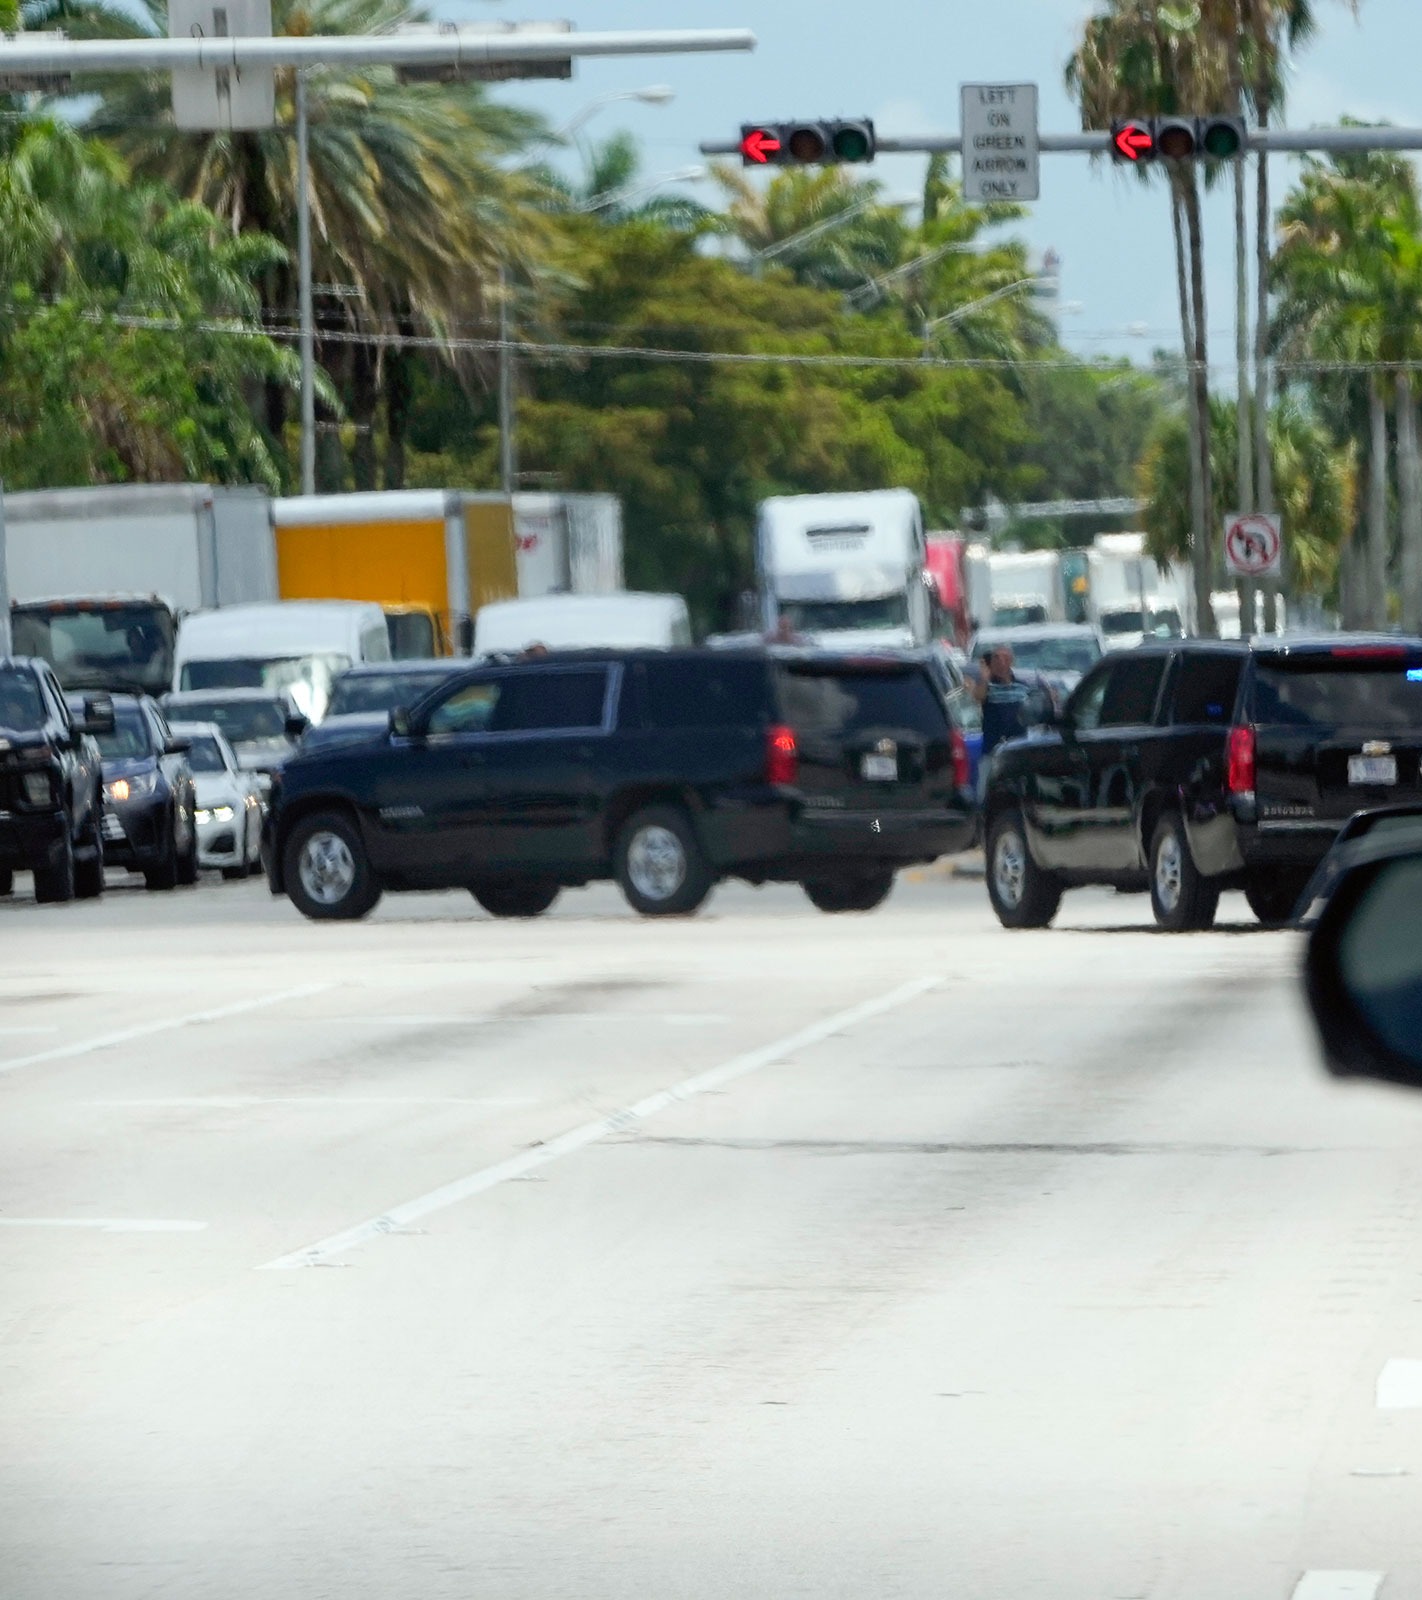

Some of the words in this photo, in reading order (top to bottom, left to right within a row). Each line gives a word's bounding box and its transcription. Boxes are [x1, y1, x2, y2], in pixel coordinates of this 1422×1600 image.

[980, 89, 1015, 103] LEFT
[987, 111, 1011, 127] ON
[973, 134, 1025, 150] GREEN
[973, 158, 1027, 173] ARROW
[980, 181, 1018, 197] ONLY
